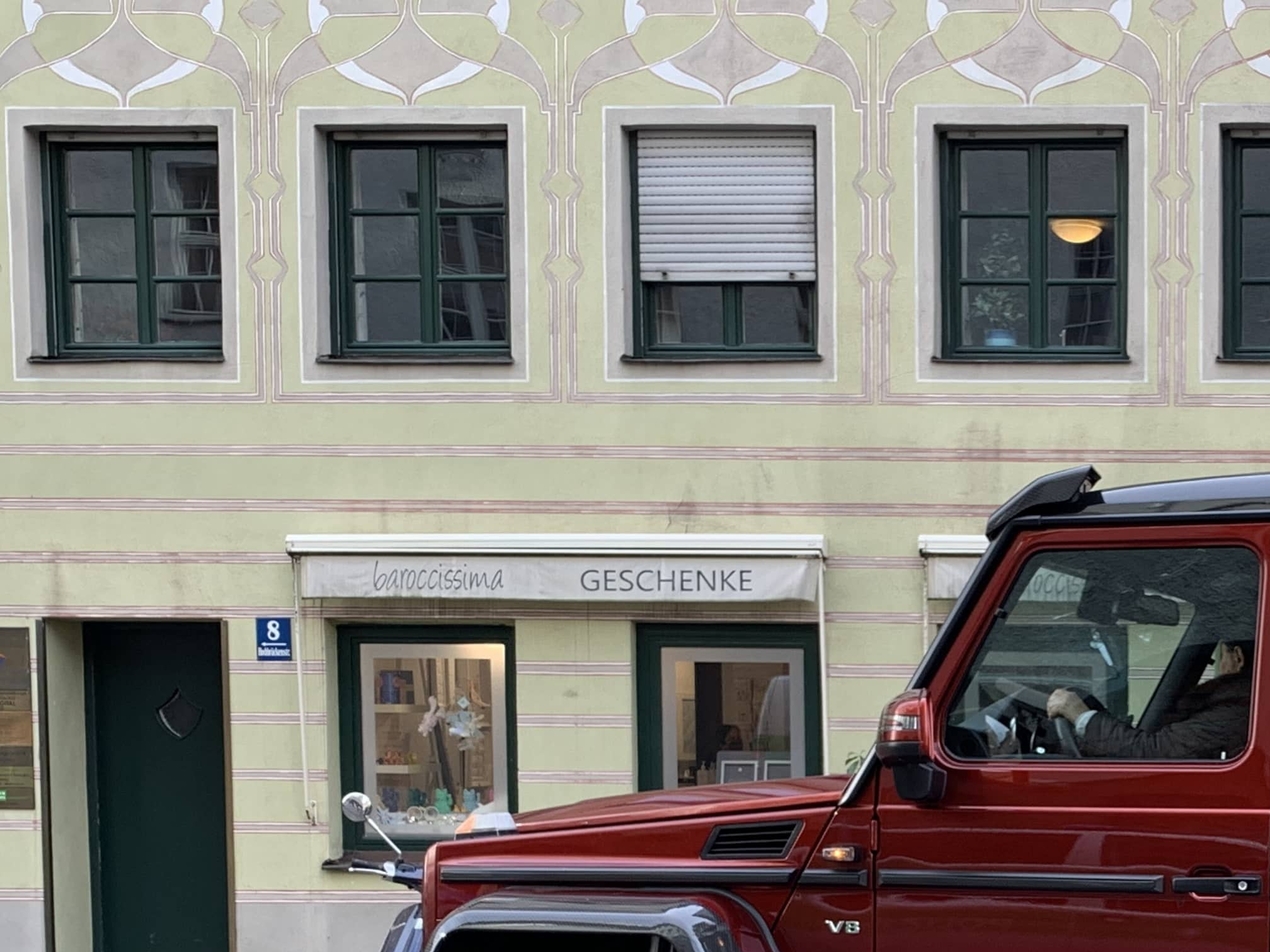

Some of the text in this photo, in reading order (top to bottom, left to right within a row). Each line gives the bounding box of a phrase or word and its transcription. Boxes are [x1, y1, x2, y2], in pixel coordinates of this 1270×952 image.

[373, 561, 753, 592] baroccissima GESCHENKE
[267, 620, 280, 641] 8
[825, 919, 860, 933] V8
